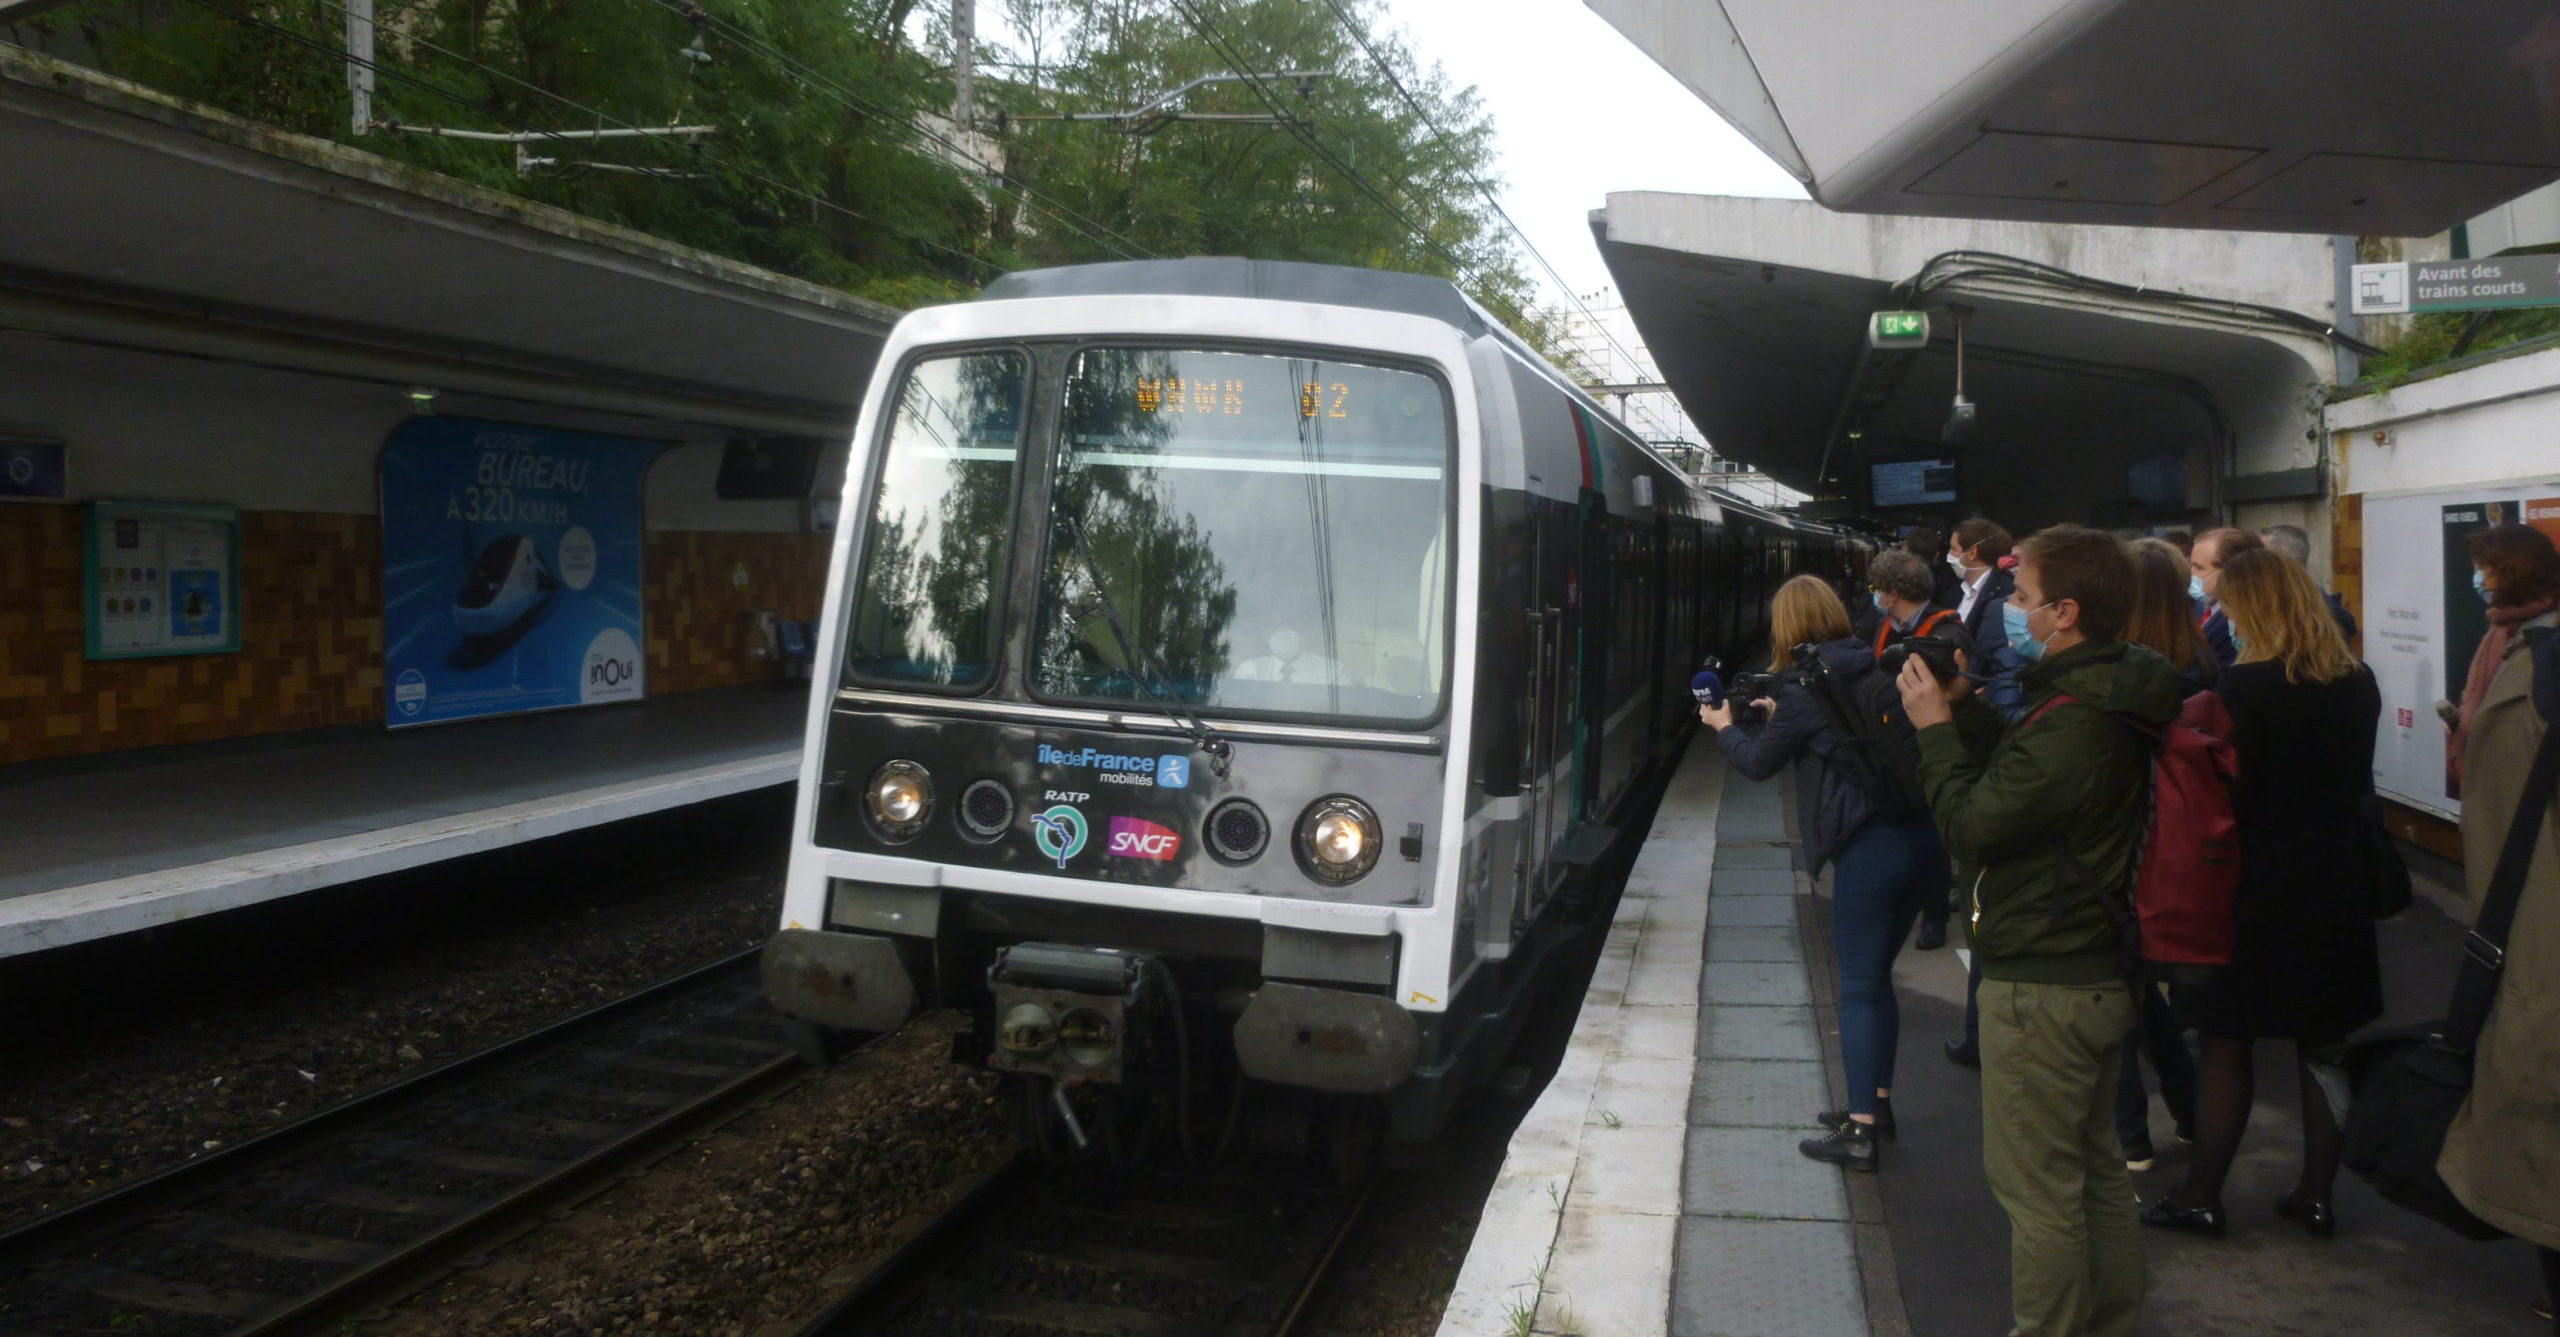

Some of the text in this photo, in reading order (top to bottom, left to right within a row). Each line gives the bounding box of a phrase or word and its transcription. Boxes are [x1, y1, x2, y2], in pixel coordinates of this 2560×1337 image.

[2418, 264, 2501, 281] Avant des
[2418, 281, 2525, 299] trains courts
[478, 450, 590, 496] BUREAU,
[464, 485, 514, 523] 320
[1099, 772, 1153, 786] mobilités
[1044, 790, 1090, 803] RATP
[1110, 832, 1177, 854] SNCF
